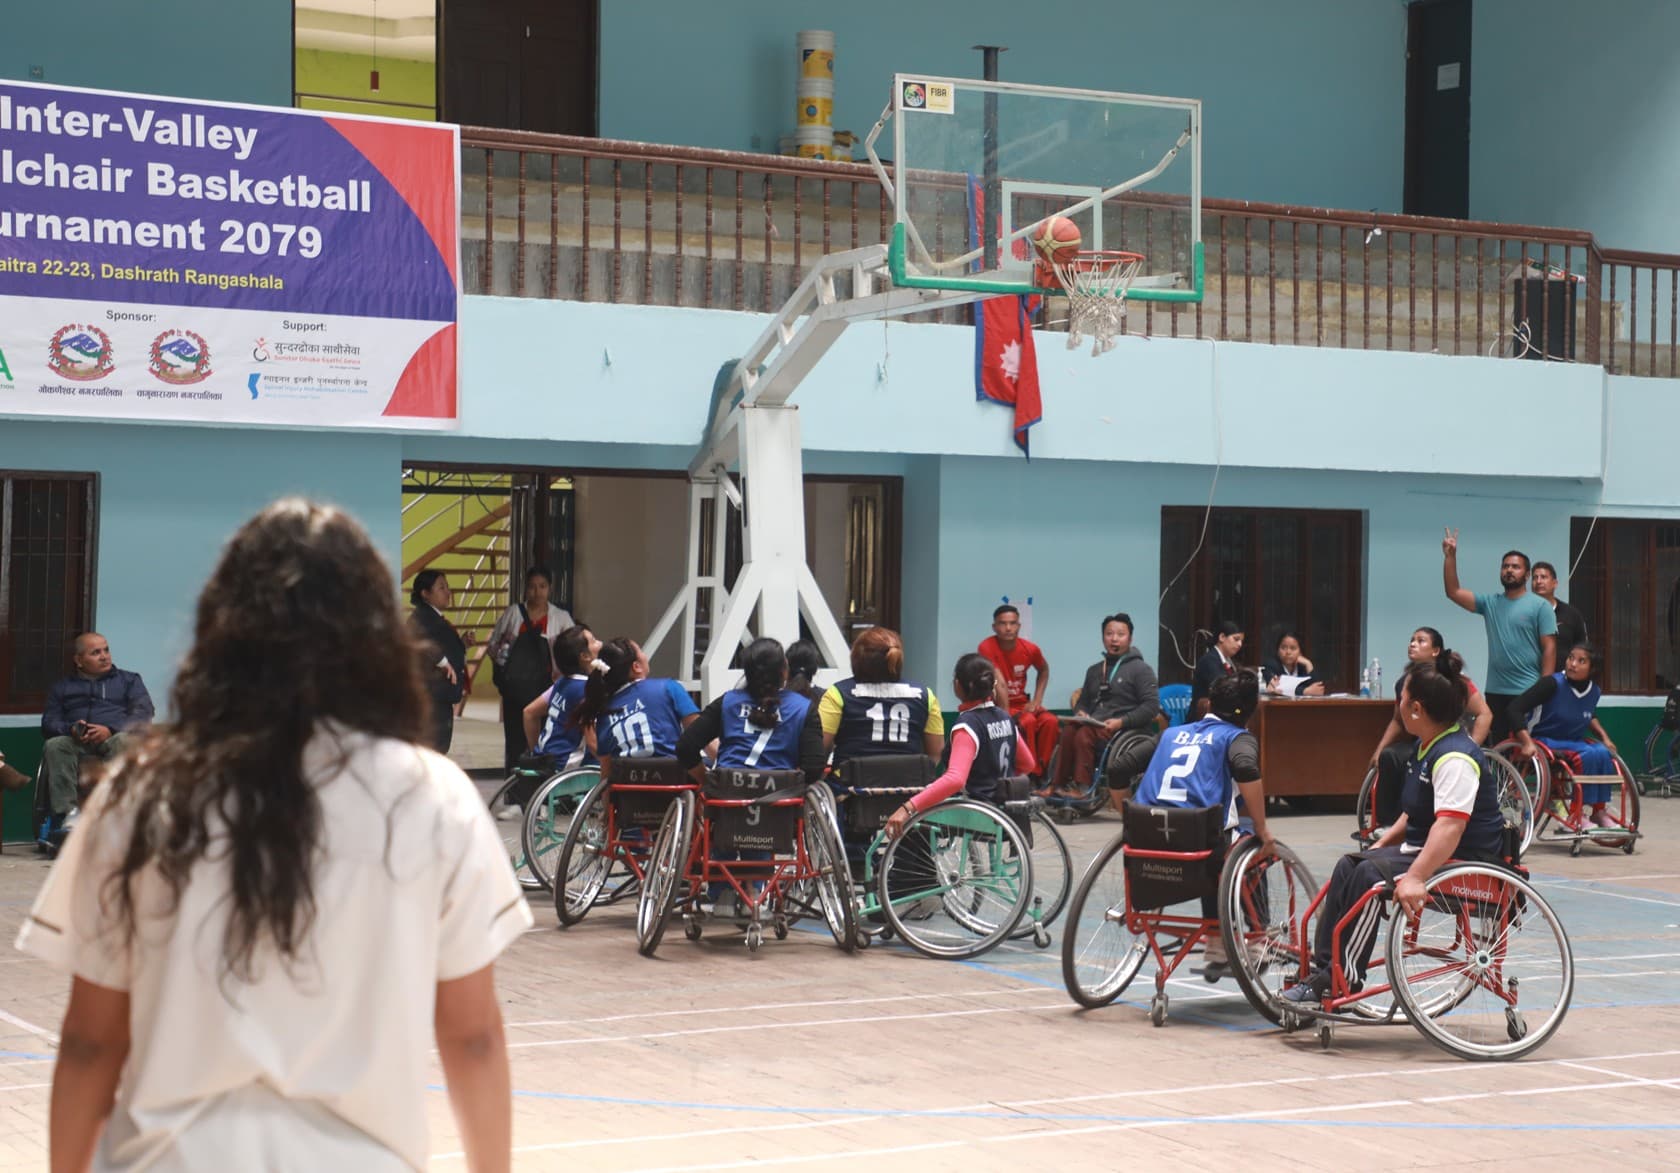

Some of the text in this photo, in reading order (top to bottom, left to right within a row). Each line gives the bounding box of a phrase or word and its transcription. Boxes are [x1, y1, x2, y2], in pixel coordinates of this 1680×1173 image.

[930, 87, 947, 97] FIBA
[0, 96, 258, 160] Inter-Valley
[2, 150, 371, 212] lchair Basketball
[220, 220, 323, 258] 2079
[43, 259, 95, 279] 22-23,
[101, 263, 179, 283] Dashrath
[185, 268, 284, 290] Rangashala
[106, 310, 157, 322] Sponsor:
[282, 319, 328, 332] Support:
[612, 711, 655, 757] 10
[743, 718, 774, 766] 7
[1156, 745, 1202, 802] 2
[1451, 885, 1494, 899] motivation
